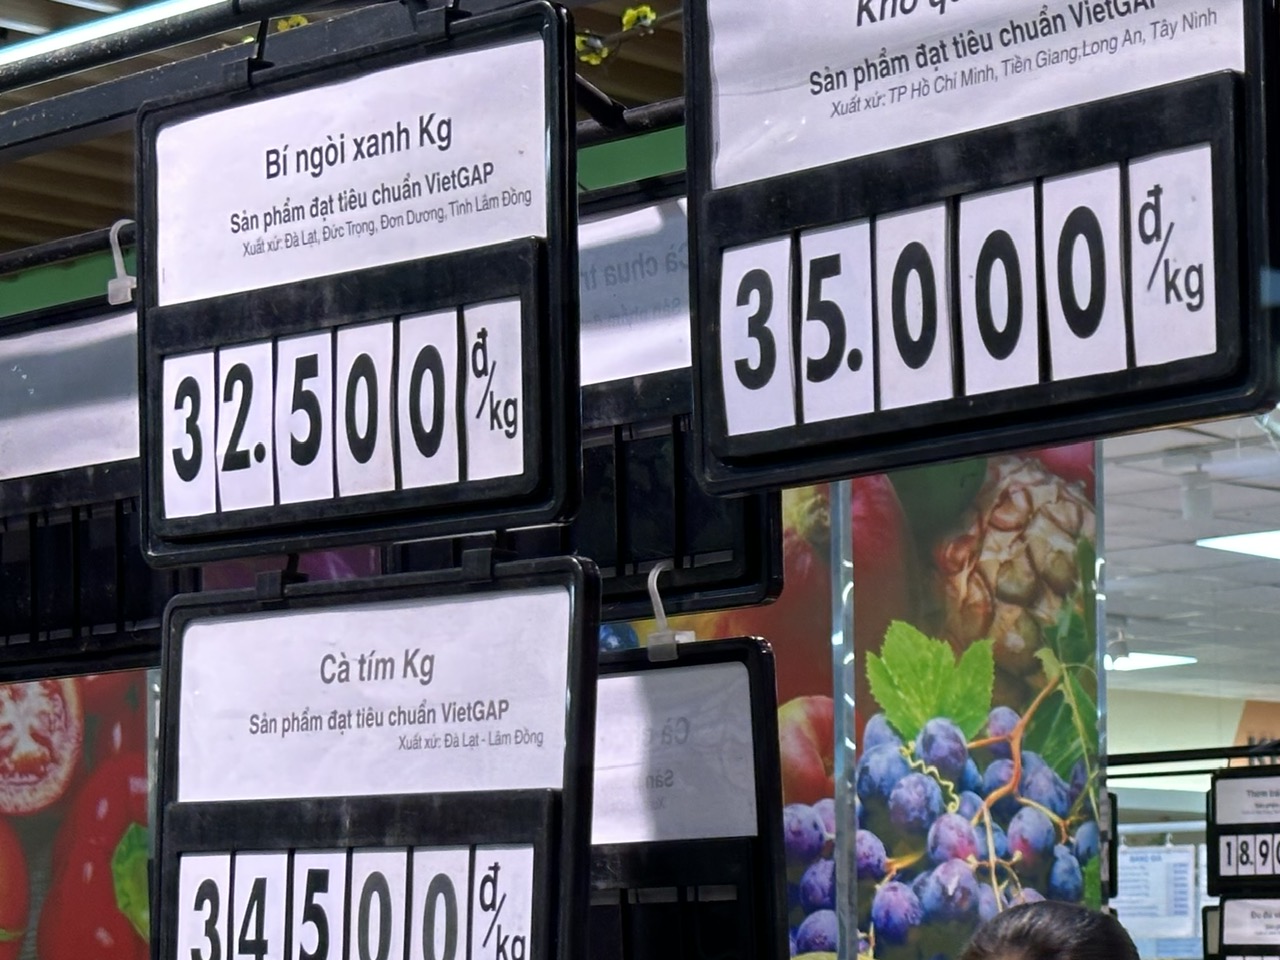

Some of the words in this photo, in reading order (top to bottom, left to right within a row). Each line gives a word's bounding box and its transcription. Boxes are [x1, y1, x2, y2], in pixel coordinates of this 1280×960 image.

[810, 66, 848, 96] Sản
[853, 47, 910, 91] phẩm
[916, 40, 950, 72] đạt
[952, 29, 993, 59] tiêu
[999, 5, 1066, 47] chuẩn
[830, 93, 861, 119] Xuất
[864, 91, 886, 111] xứ:
[888, 85, 907, 104] TP
[911, 78, 930, 99] Hồ
[961, 64, 998, 89] Minh,
[1001, 54, 1032, 77] Tiền
[1121, 29, 1146, 48] An,
[1150, 18, 1178, 41] Tây
[1182, 7, 1217, 33] Ninh
[265, 144, 289, 179] Bí
[296, 134, 345, 178] ngòi
[353, 121, 410, 162] xanh
[418, 112, 452, 151] Kg
[230, 209, 259, 234] Sản
[264, 197, 305, 232] phẩm
[310, 196, 334, 223] đạt
[337, 188, 367, 213] tiêu
[372, 172, 422, 206] chuẩn
[425, 162, 494, 194] VietGAP
[284, 229, 299, 249] Đà
[301, 228, 320, 248] Lạt,
[323, 221, 345, 241] Đức
[346, 217, 378, 239] Trọng,
[406, 205, 448, 226] Dương,
[502, 187, 532, 209] Đồng
[734, 205, 1106, 391] 35.000
[172, 344, 446, 482] 32.500
[320, 652, 350, 684] Cà
[358, 650, 394, 682] tím
[402, 648, 435, 685] Kg
[249, 713, 277, 735] Sản
[281, 706, 323, 738] phẩm
[328, 709, 352, 735] đạt
[355, 706, 384, 728] tiêu
[388, 699, 436, 726] chuẩn
[441, 699, 509, 723] VietGAP
[444, 731, 459, 748] Đà
[462, 732, 479, 751] Lạt
[488, 731, 511, 747] Lâm
[514, 728, 544, 748] Đồng
